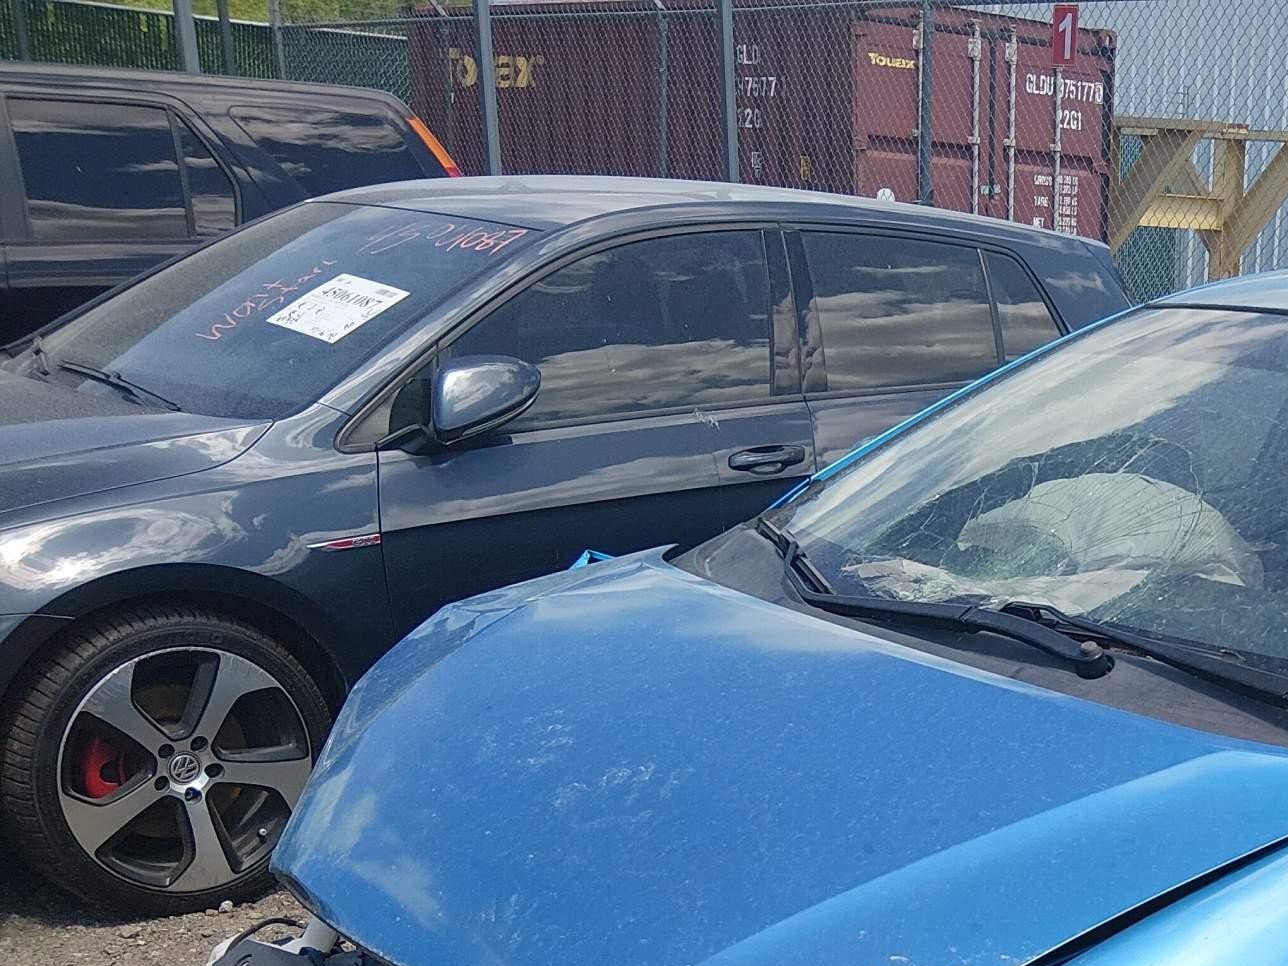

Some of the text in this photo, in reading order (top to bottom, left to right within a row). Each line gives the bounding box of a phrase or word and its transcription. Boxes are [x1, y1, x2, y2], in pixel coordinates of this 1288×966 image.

[1058, 12, 1073, 60] 1
[1026, 72, 1055, 96] GLDU
[321, 287, 383, 308] 45061087
